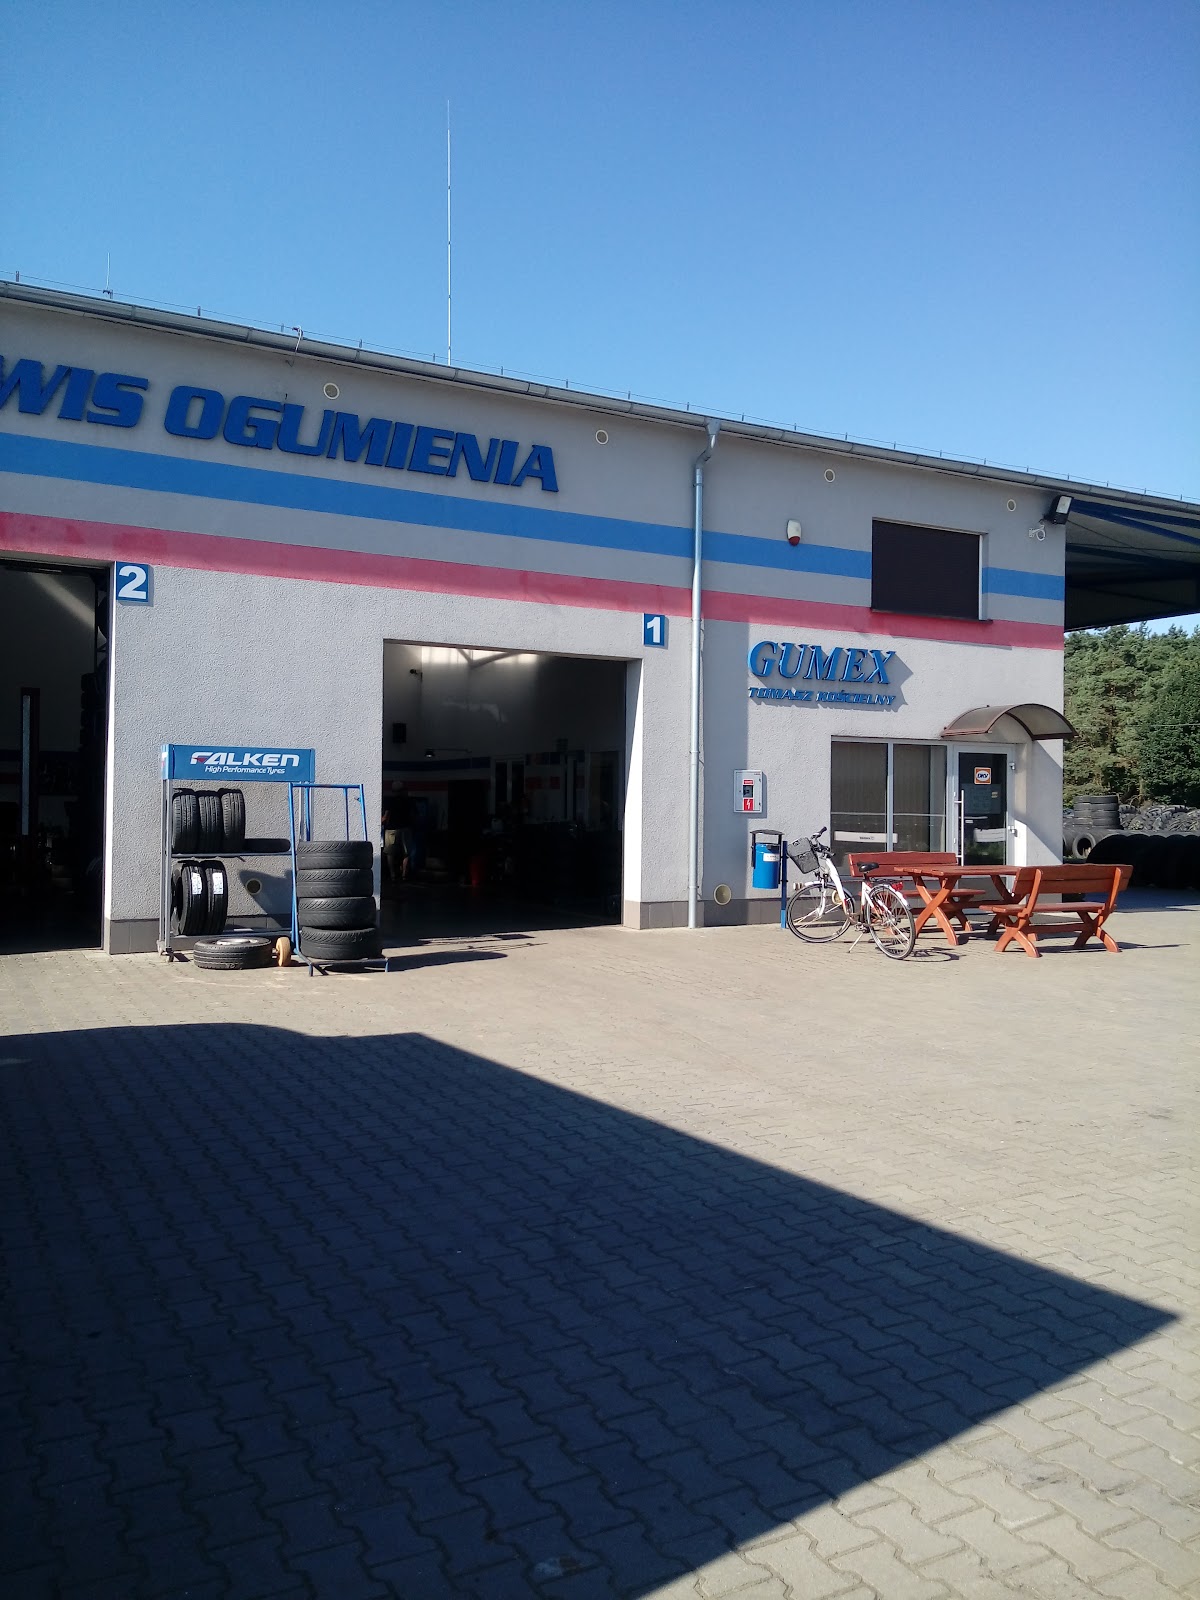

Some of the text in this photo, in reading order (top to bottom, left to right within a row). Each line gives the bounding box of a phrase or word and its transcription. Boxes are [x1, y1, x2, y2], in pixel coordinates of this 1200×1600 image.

[164, 385, 559, 492] OGUMIENIA
[118, 565, 146, 599] 2
[646, 616, 660, 643] 1
[747, 640, 896, 684] GUMEX
[748, 687, 896, 705] TOMASZ KOŚCIELNY
[190, 751, 299, 767] FALKEN
[205, 765, 285, 774] High Performance Tyres
